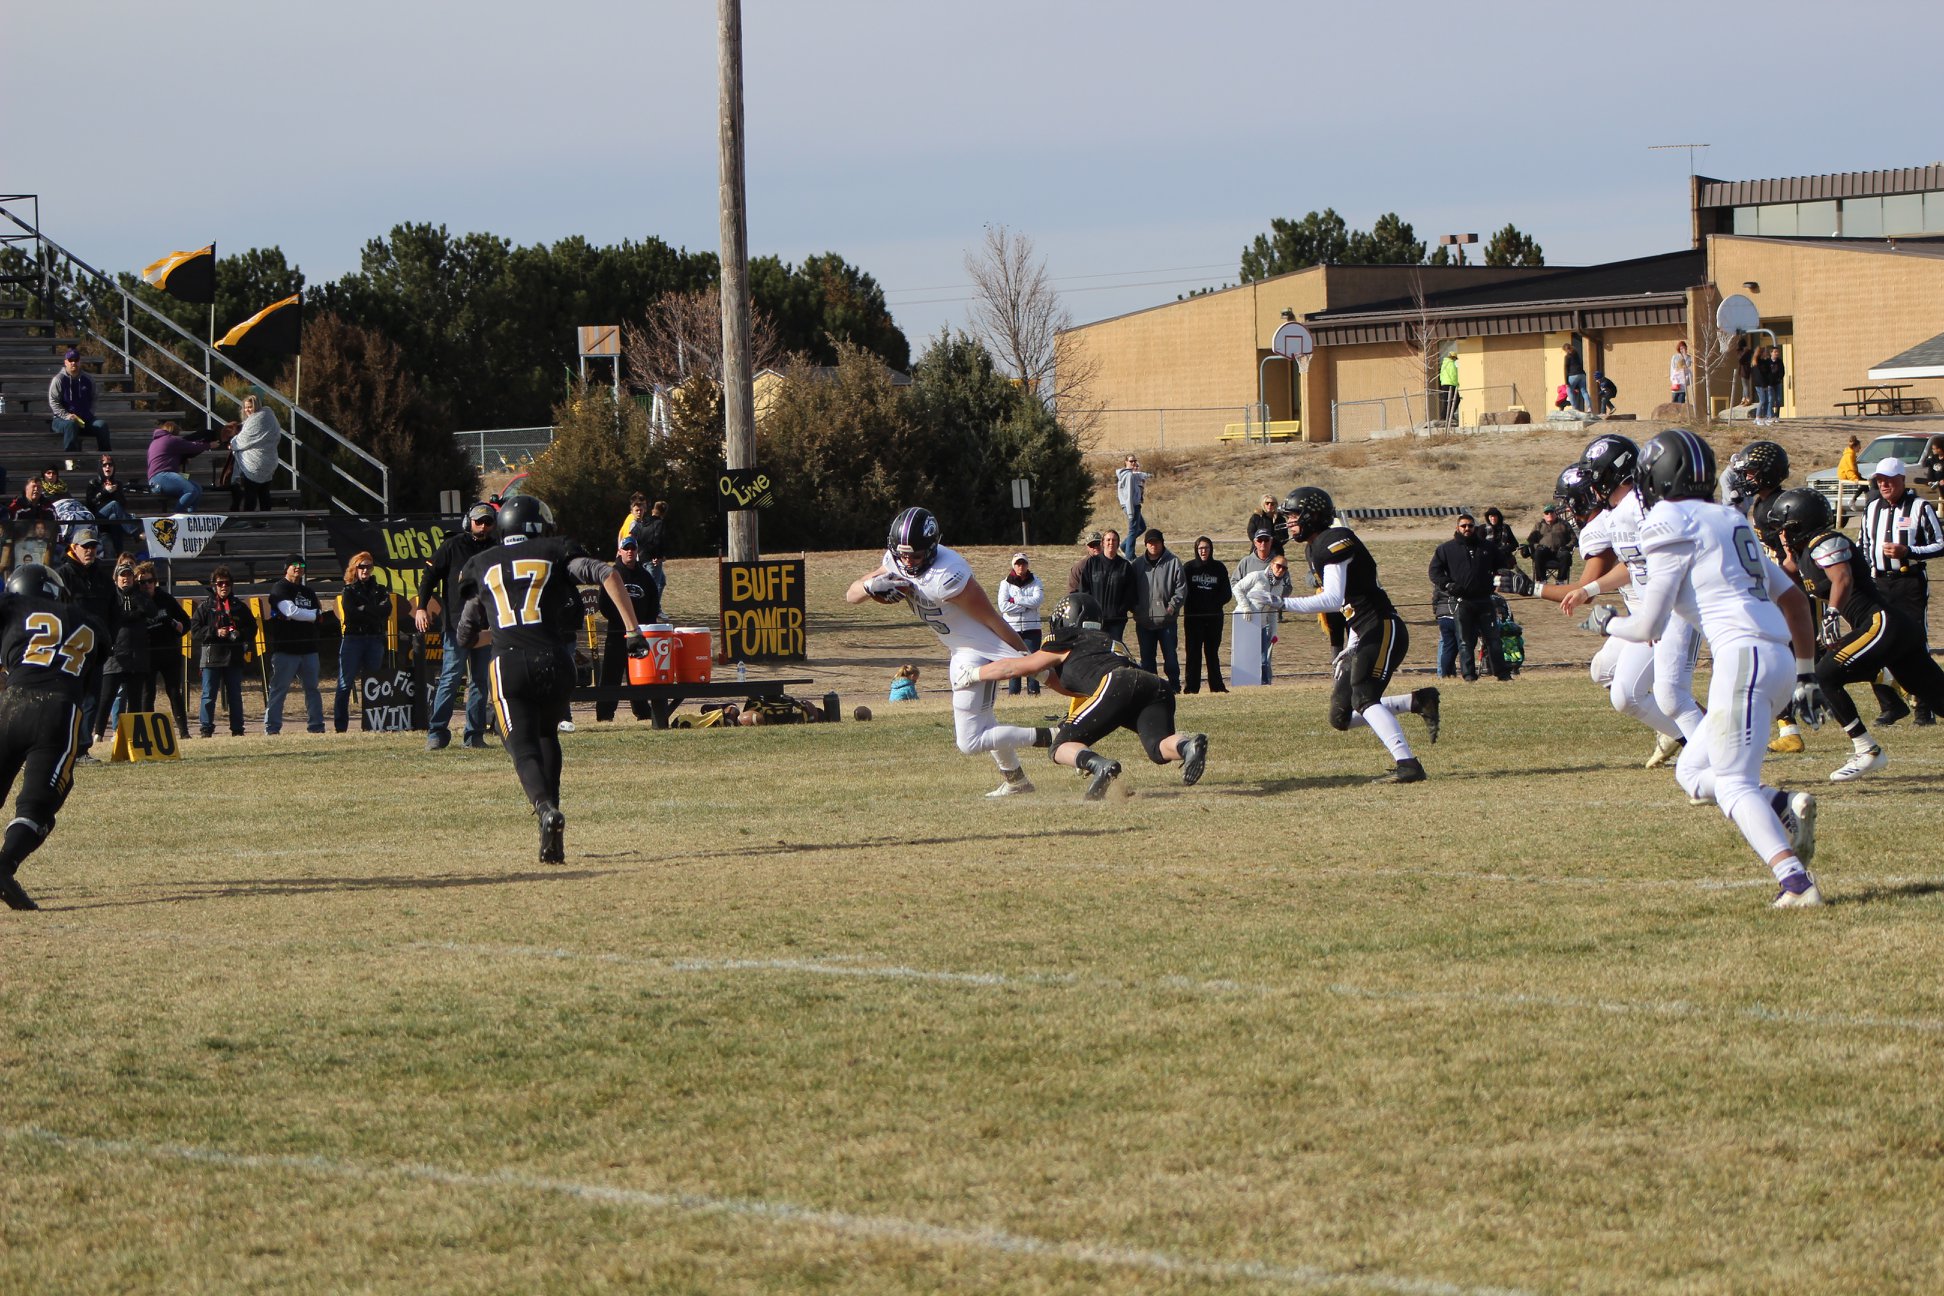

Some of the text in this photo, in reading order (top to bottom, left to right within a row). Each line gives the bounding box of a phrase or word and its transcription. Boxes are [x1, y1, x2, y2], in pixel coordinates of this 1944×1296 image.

[731, 564, 795, 602] BUFF
[1732, 525, 1770, 602] 9
[484, 559, 552, 628] 17
[22, 612, 95, 676] 24
[656, 639, 671, 656] G
[724, 605, 804, 659] POWER
[132, 713, 176, 756] 40
[365, 704, 414, 731] WIN
